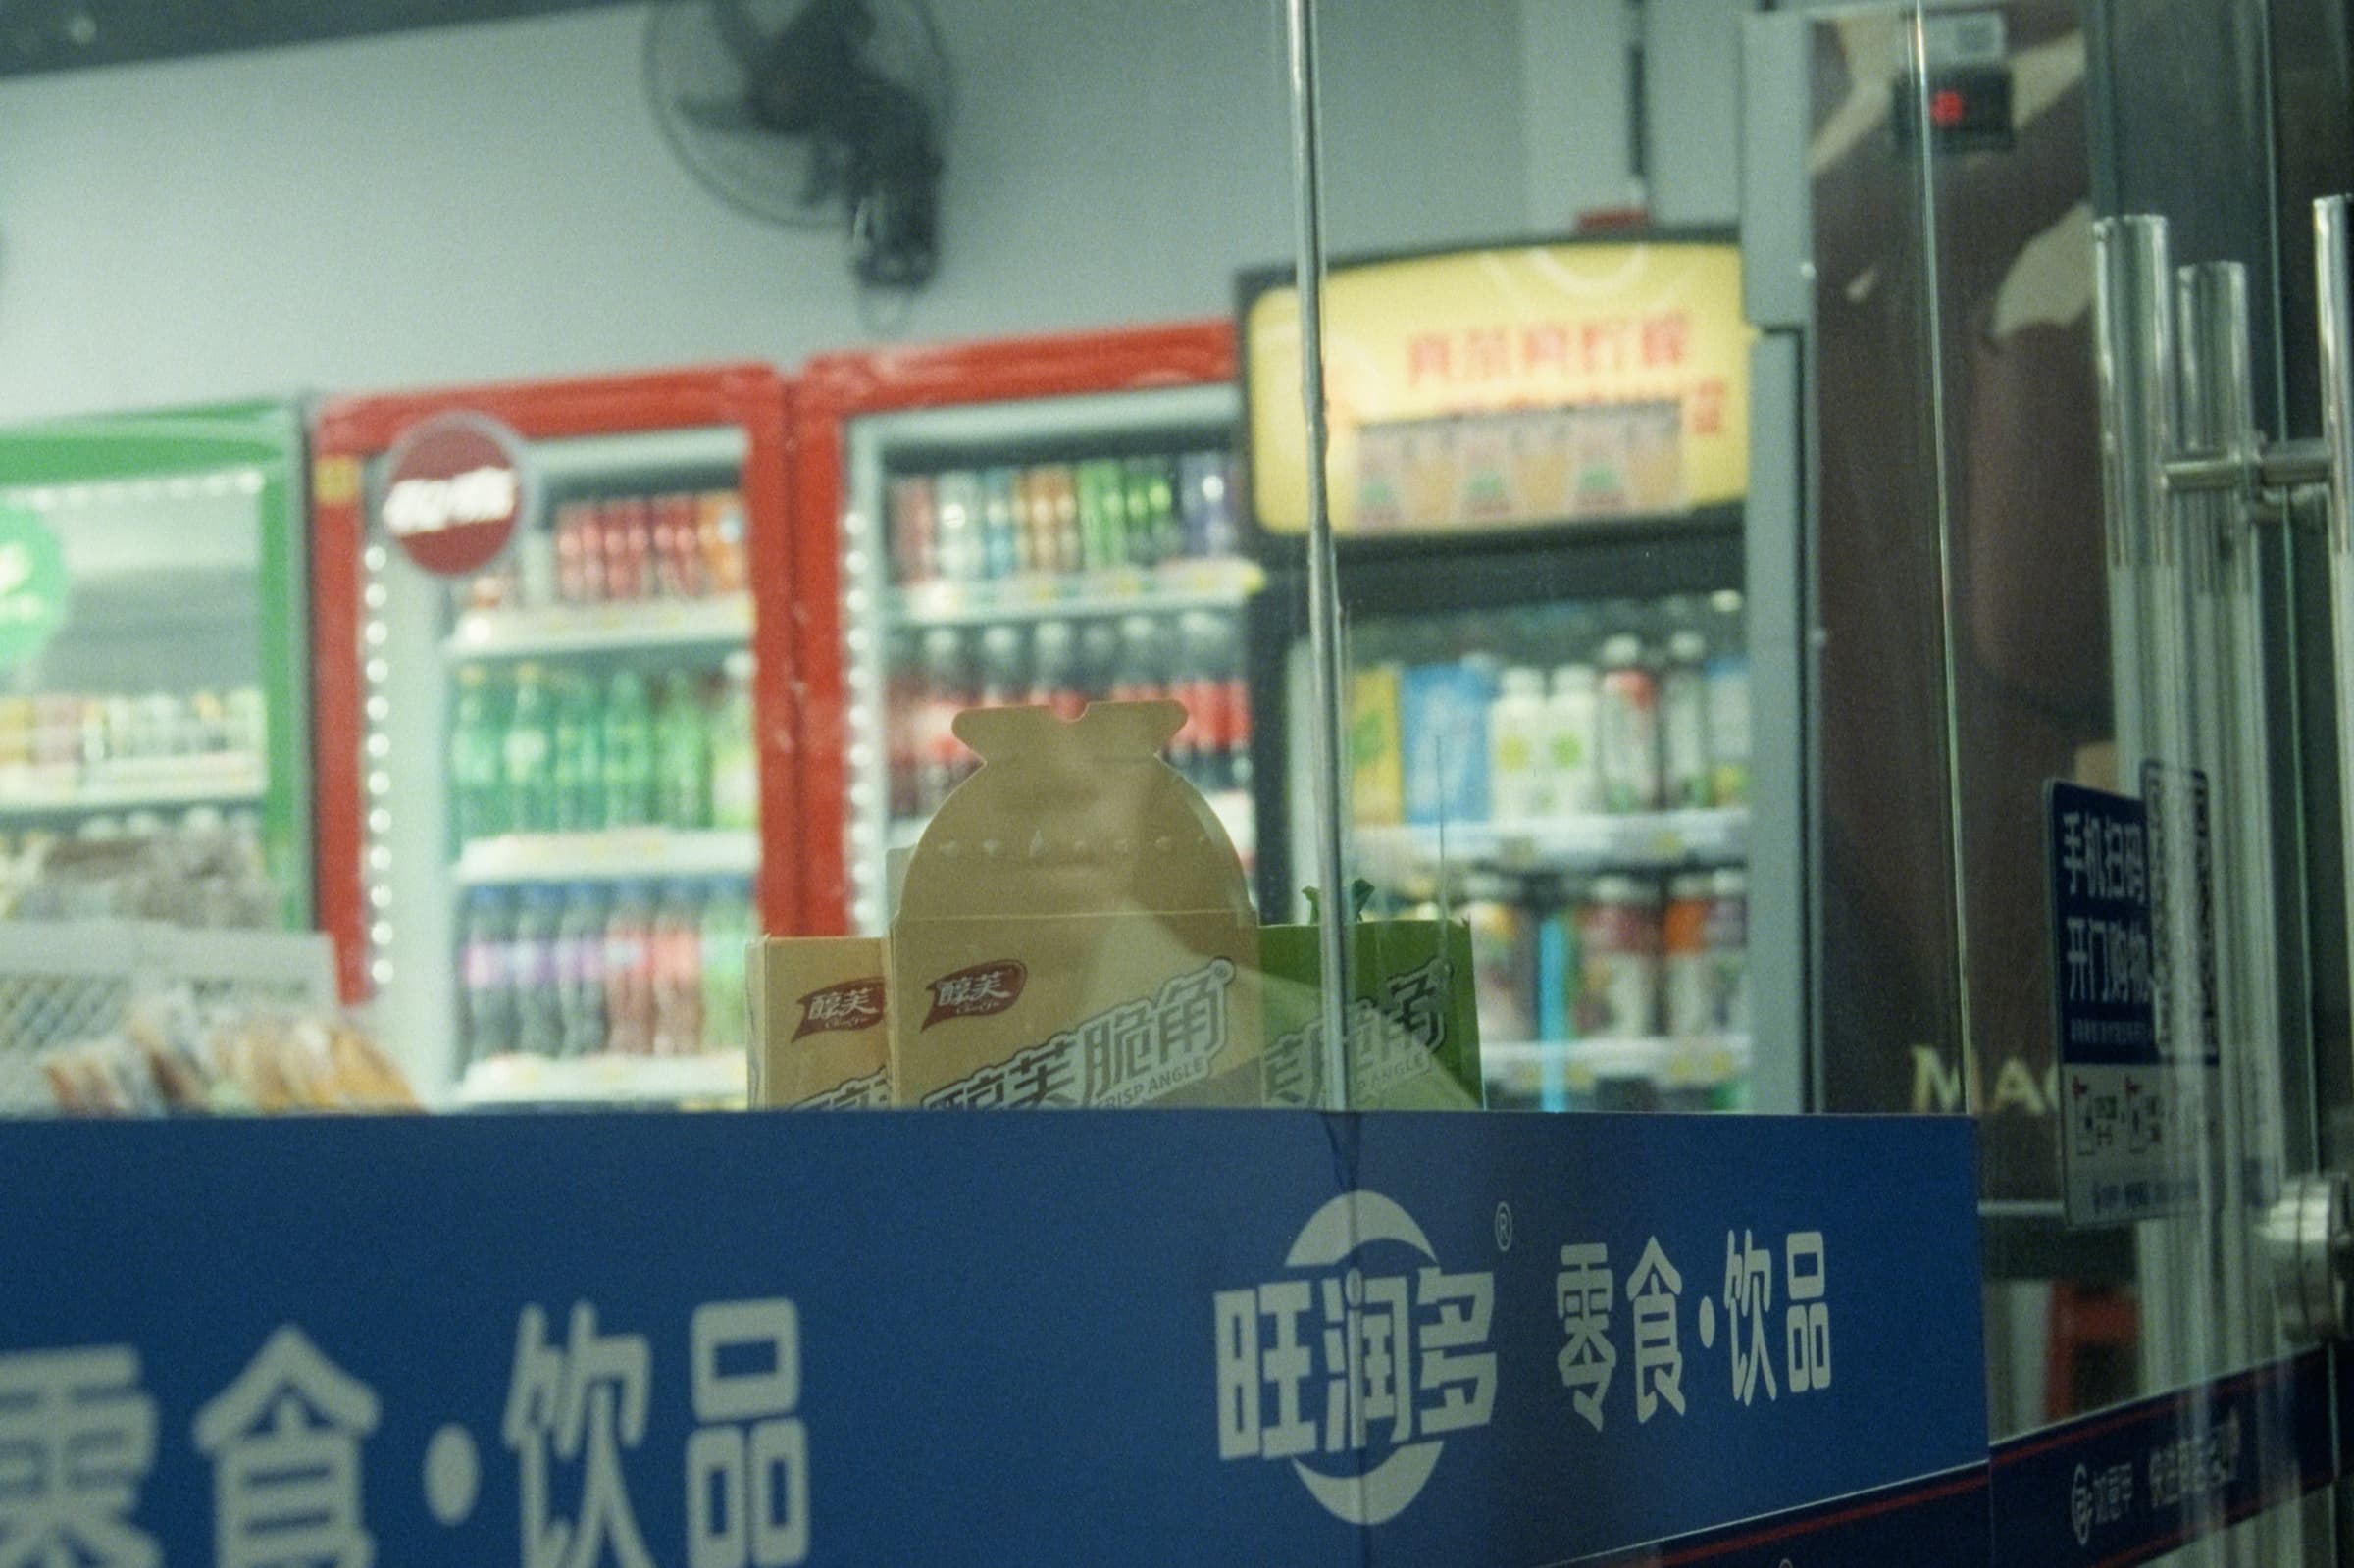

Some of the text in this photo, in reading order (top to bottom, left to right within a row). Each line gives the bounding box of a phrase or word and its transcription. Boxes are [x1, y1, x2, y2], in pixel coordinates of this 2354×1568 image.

[1149, 1058, 1204, 1098] ANGLE
[1212, 1267, 1497, 1460] 旺润多
